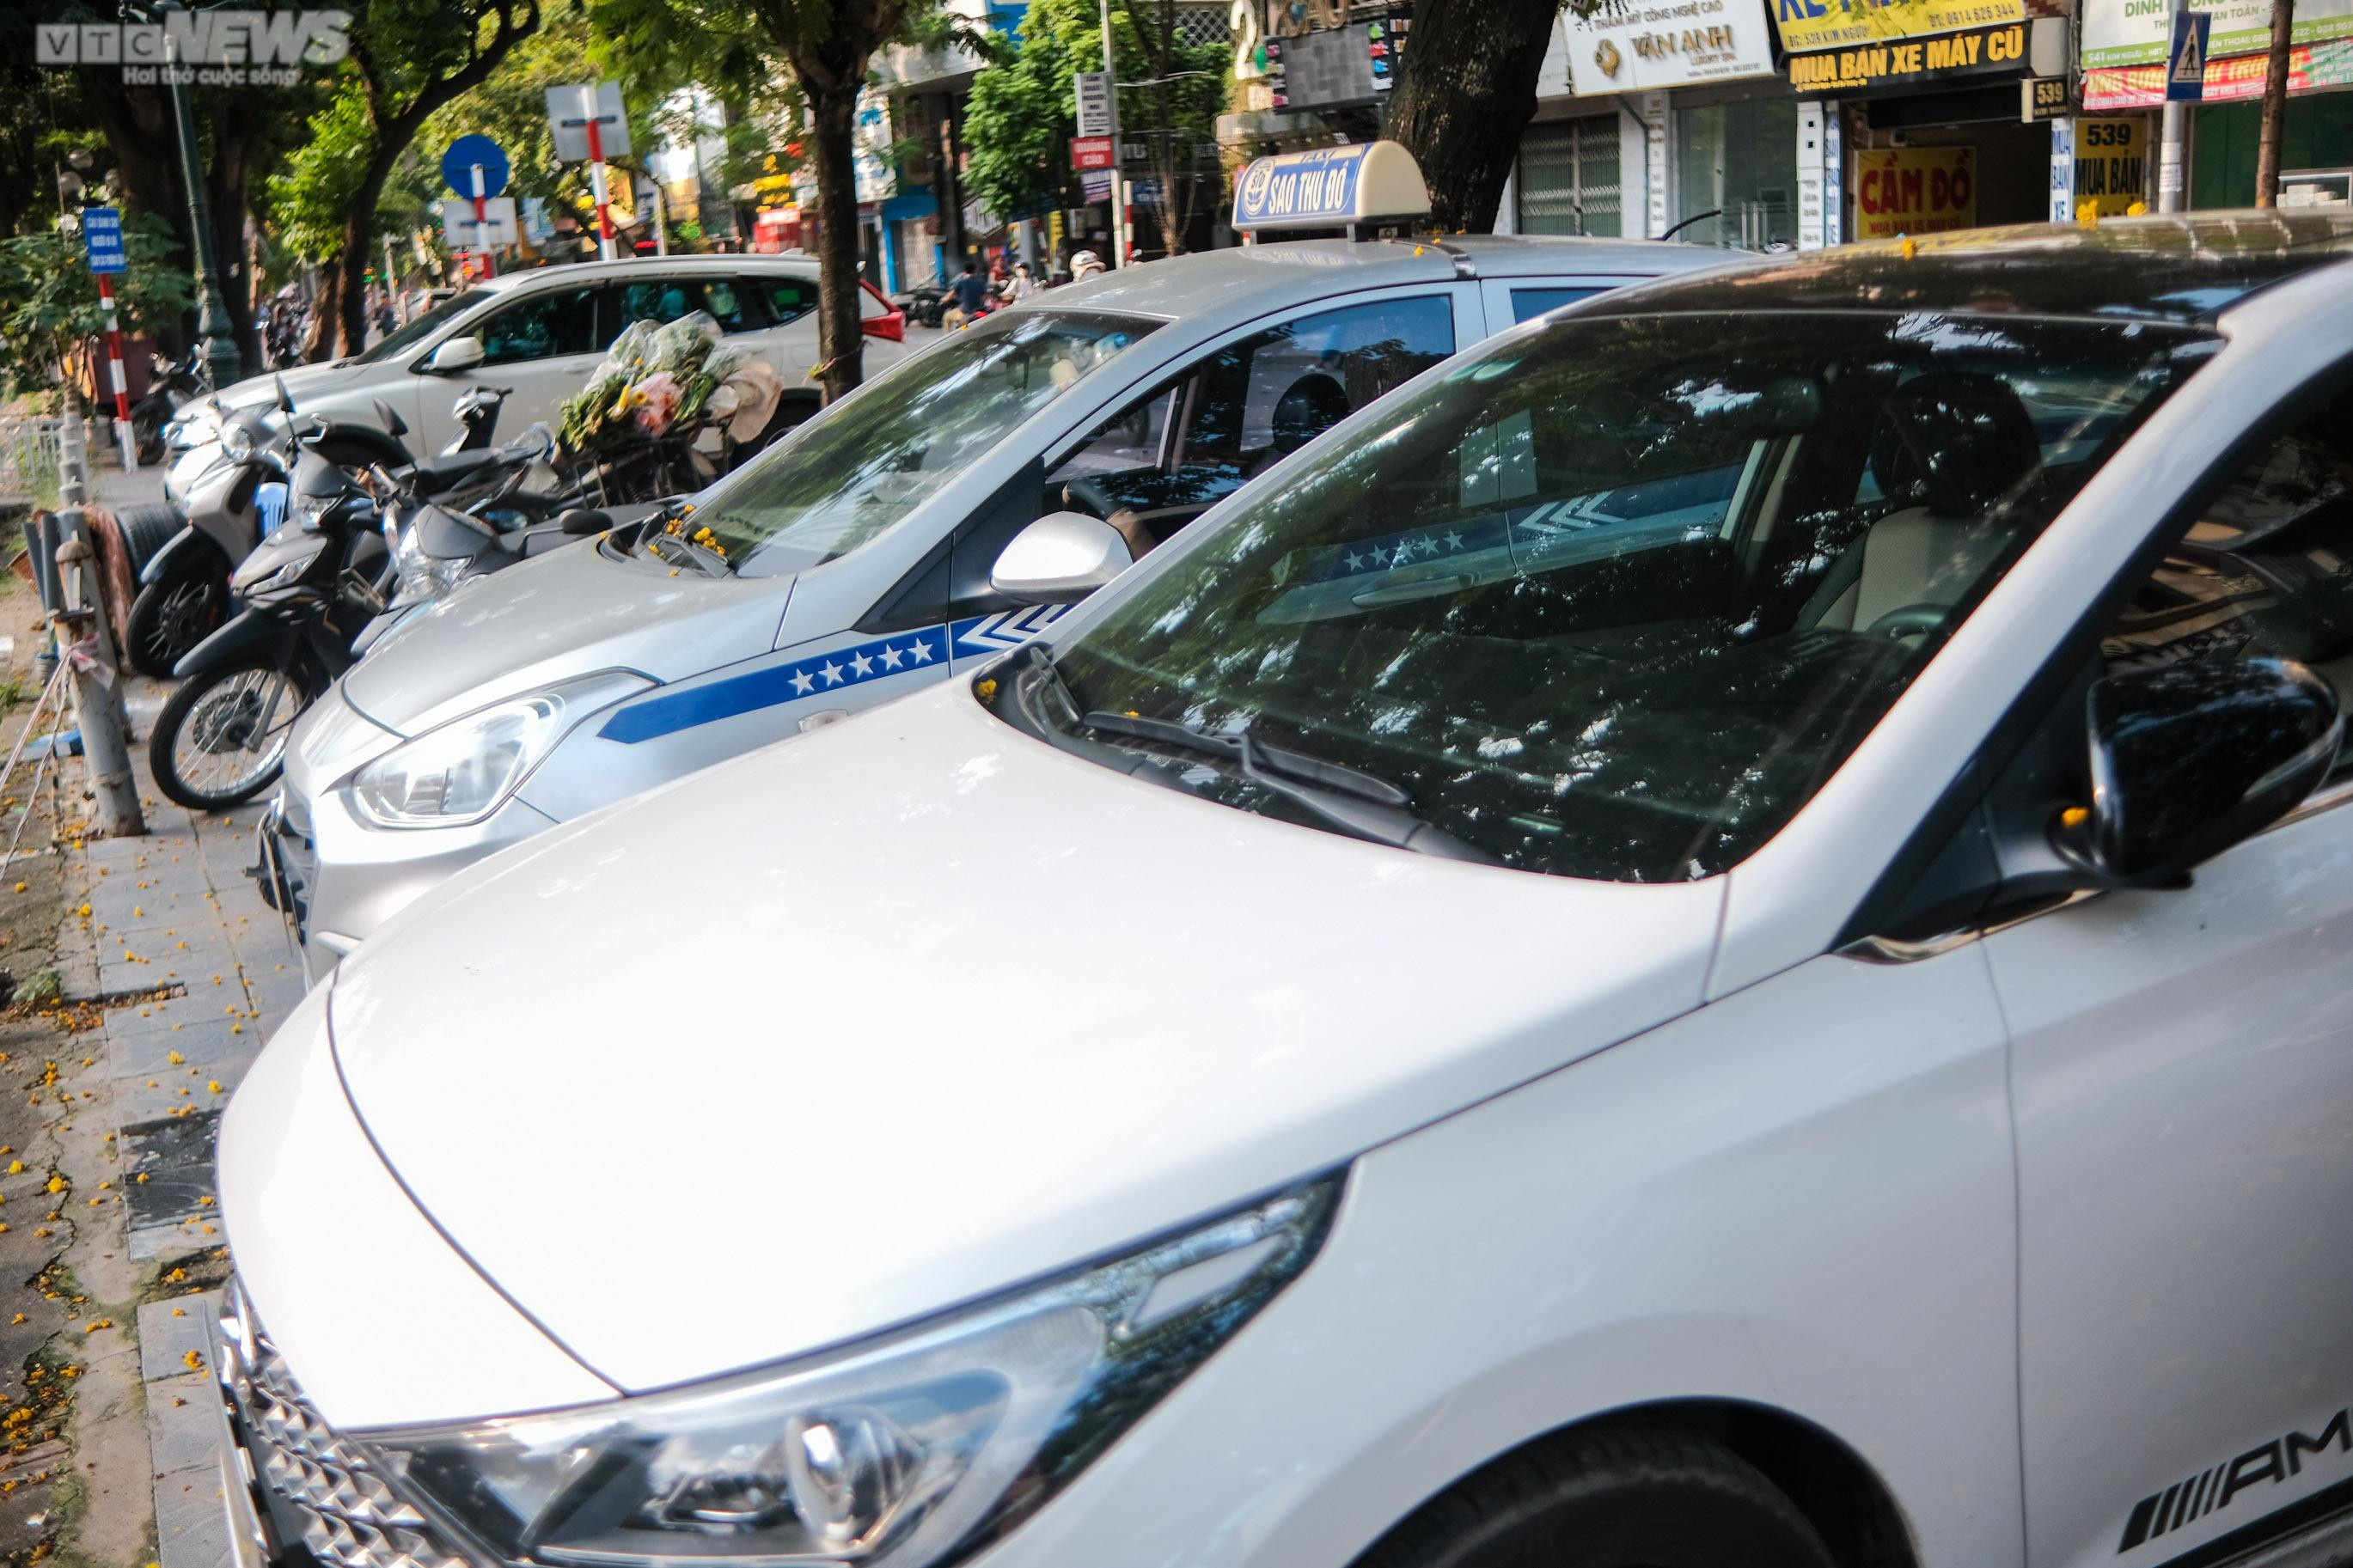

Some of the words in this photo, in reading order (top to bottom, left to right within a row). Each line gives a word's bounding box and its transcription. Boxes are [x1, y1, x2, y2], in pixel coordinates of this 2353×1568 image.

[1790, 54, 1838, 84] MUA
[1890, 44, 1922, 75] XE
[1927, 33, 1982, 70] MÁY
[2037, 82, 2064, 105] 539
[2087, 123, 2131, 146] 539
[2075, 158, 2105, 196] MUA
[2110, 149, 2142, 195] BÁN
[1268, 173, 1298, 215] SAO
